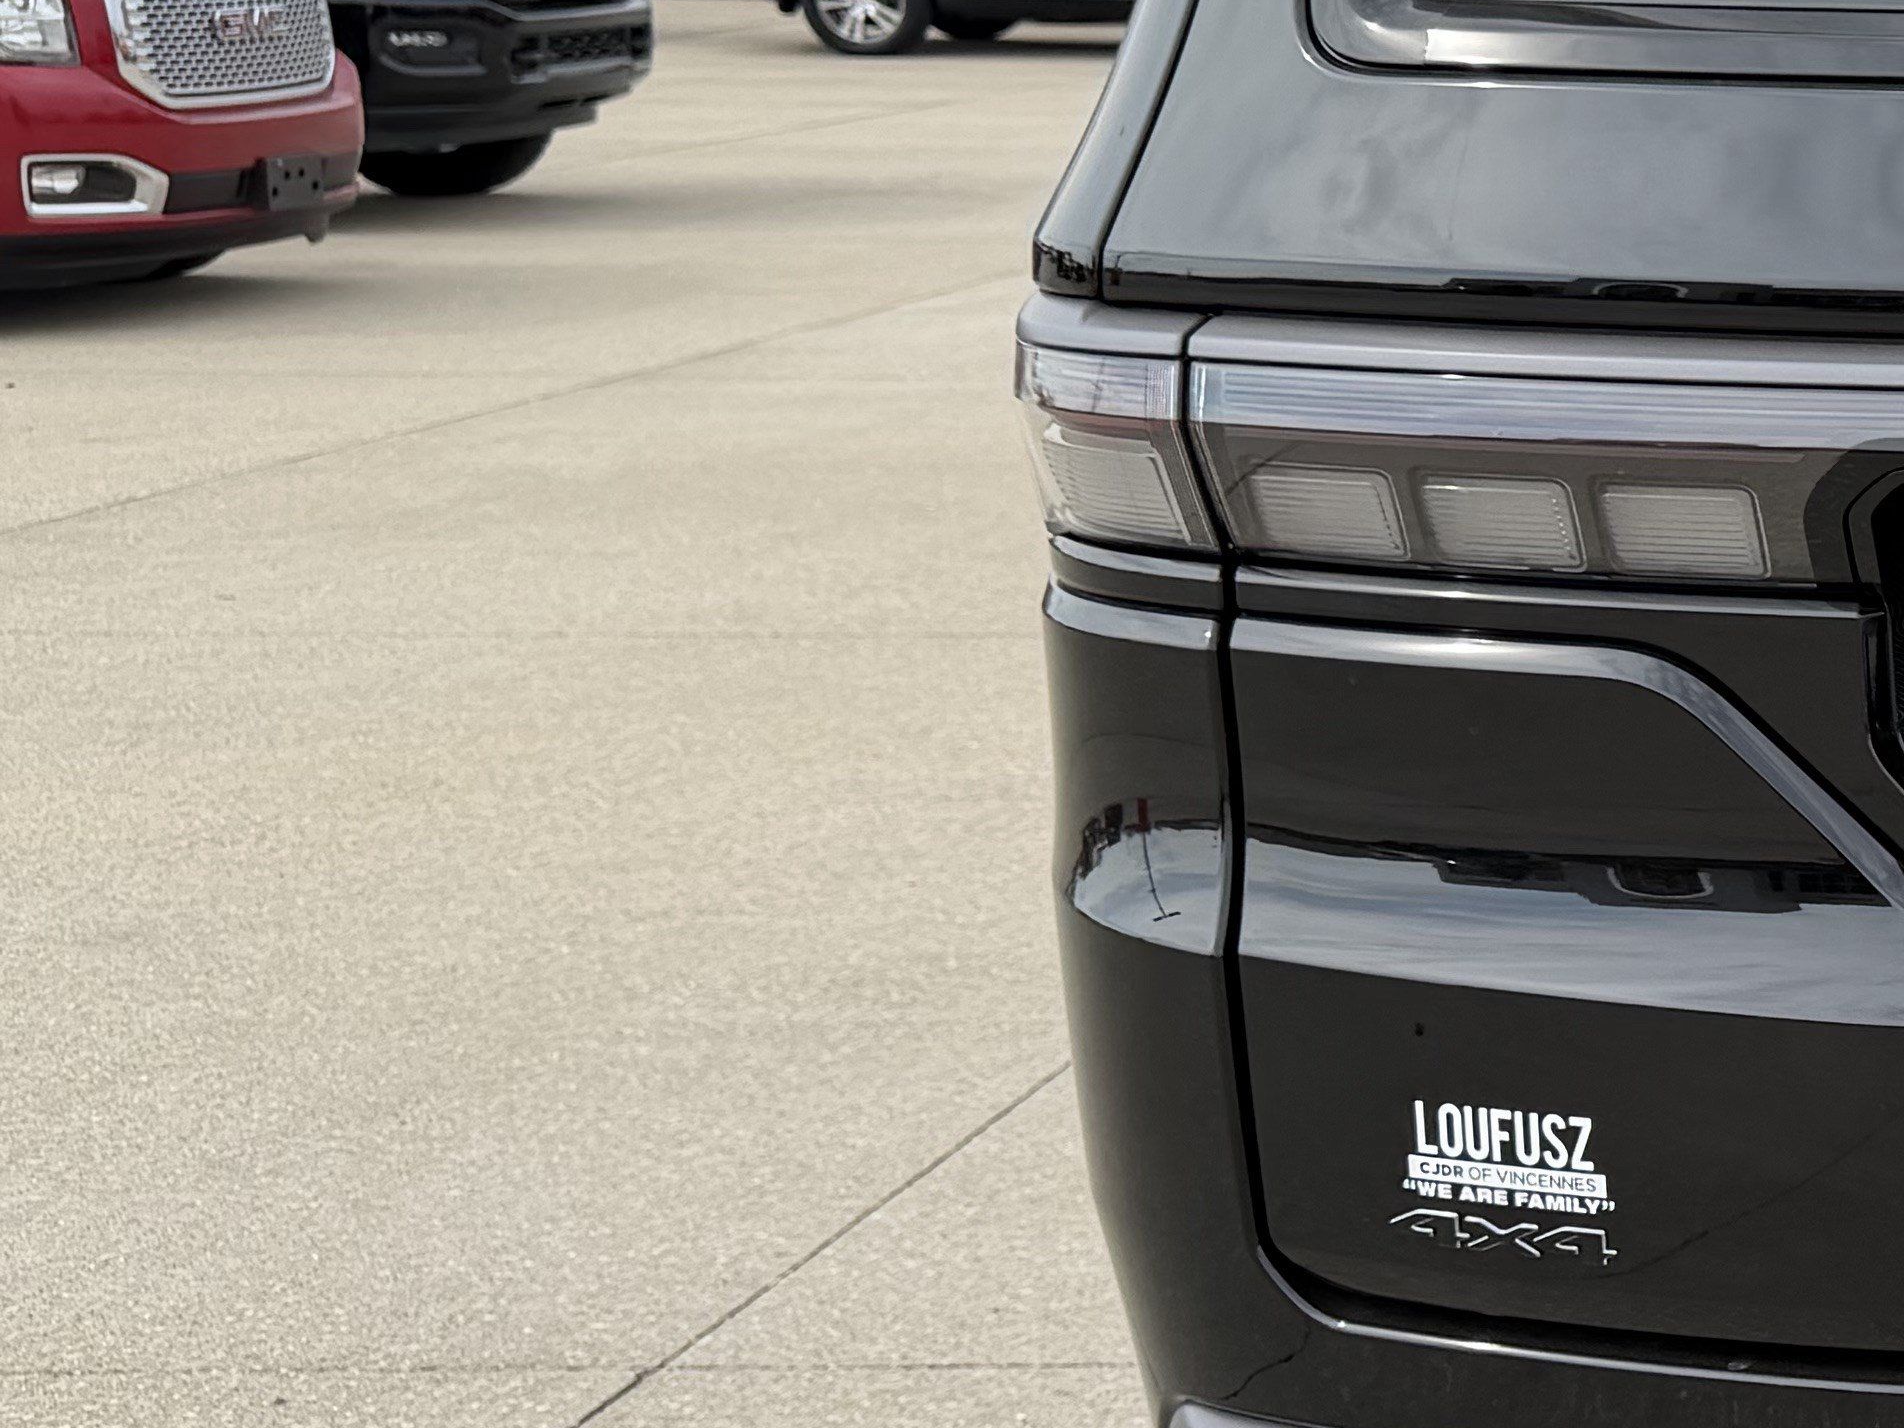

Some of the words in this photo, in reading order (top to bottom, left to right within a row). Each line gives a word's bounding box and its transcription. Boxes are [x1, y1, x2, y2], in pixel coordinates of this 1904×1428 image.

[1419, 1161, 1464, 1179] CJDR
[1467, 1166, 1494, 1181] OF
[1496, 1170, 1598, 1193] VINCENNES
[1458, 1185, 1509, 1206] ARE
